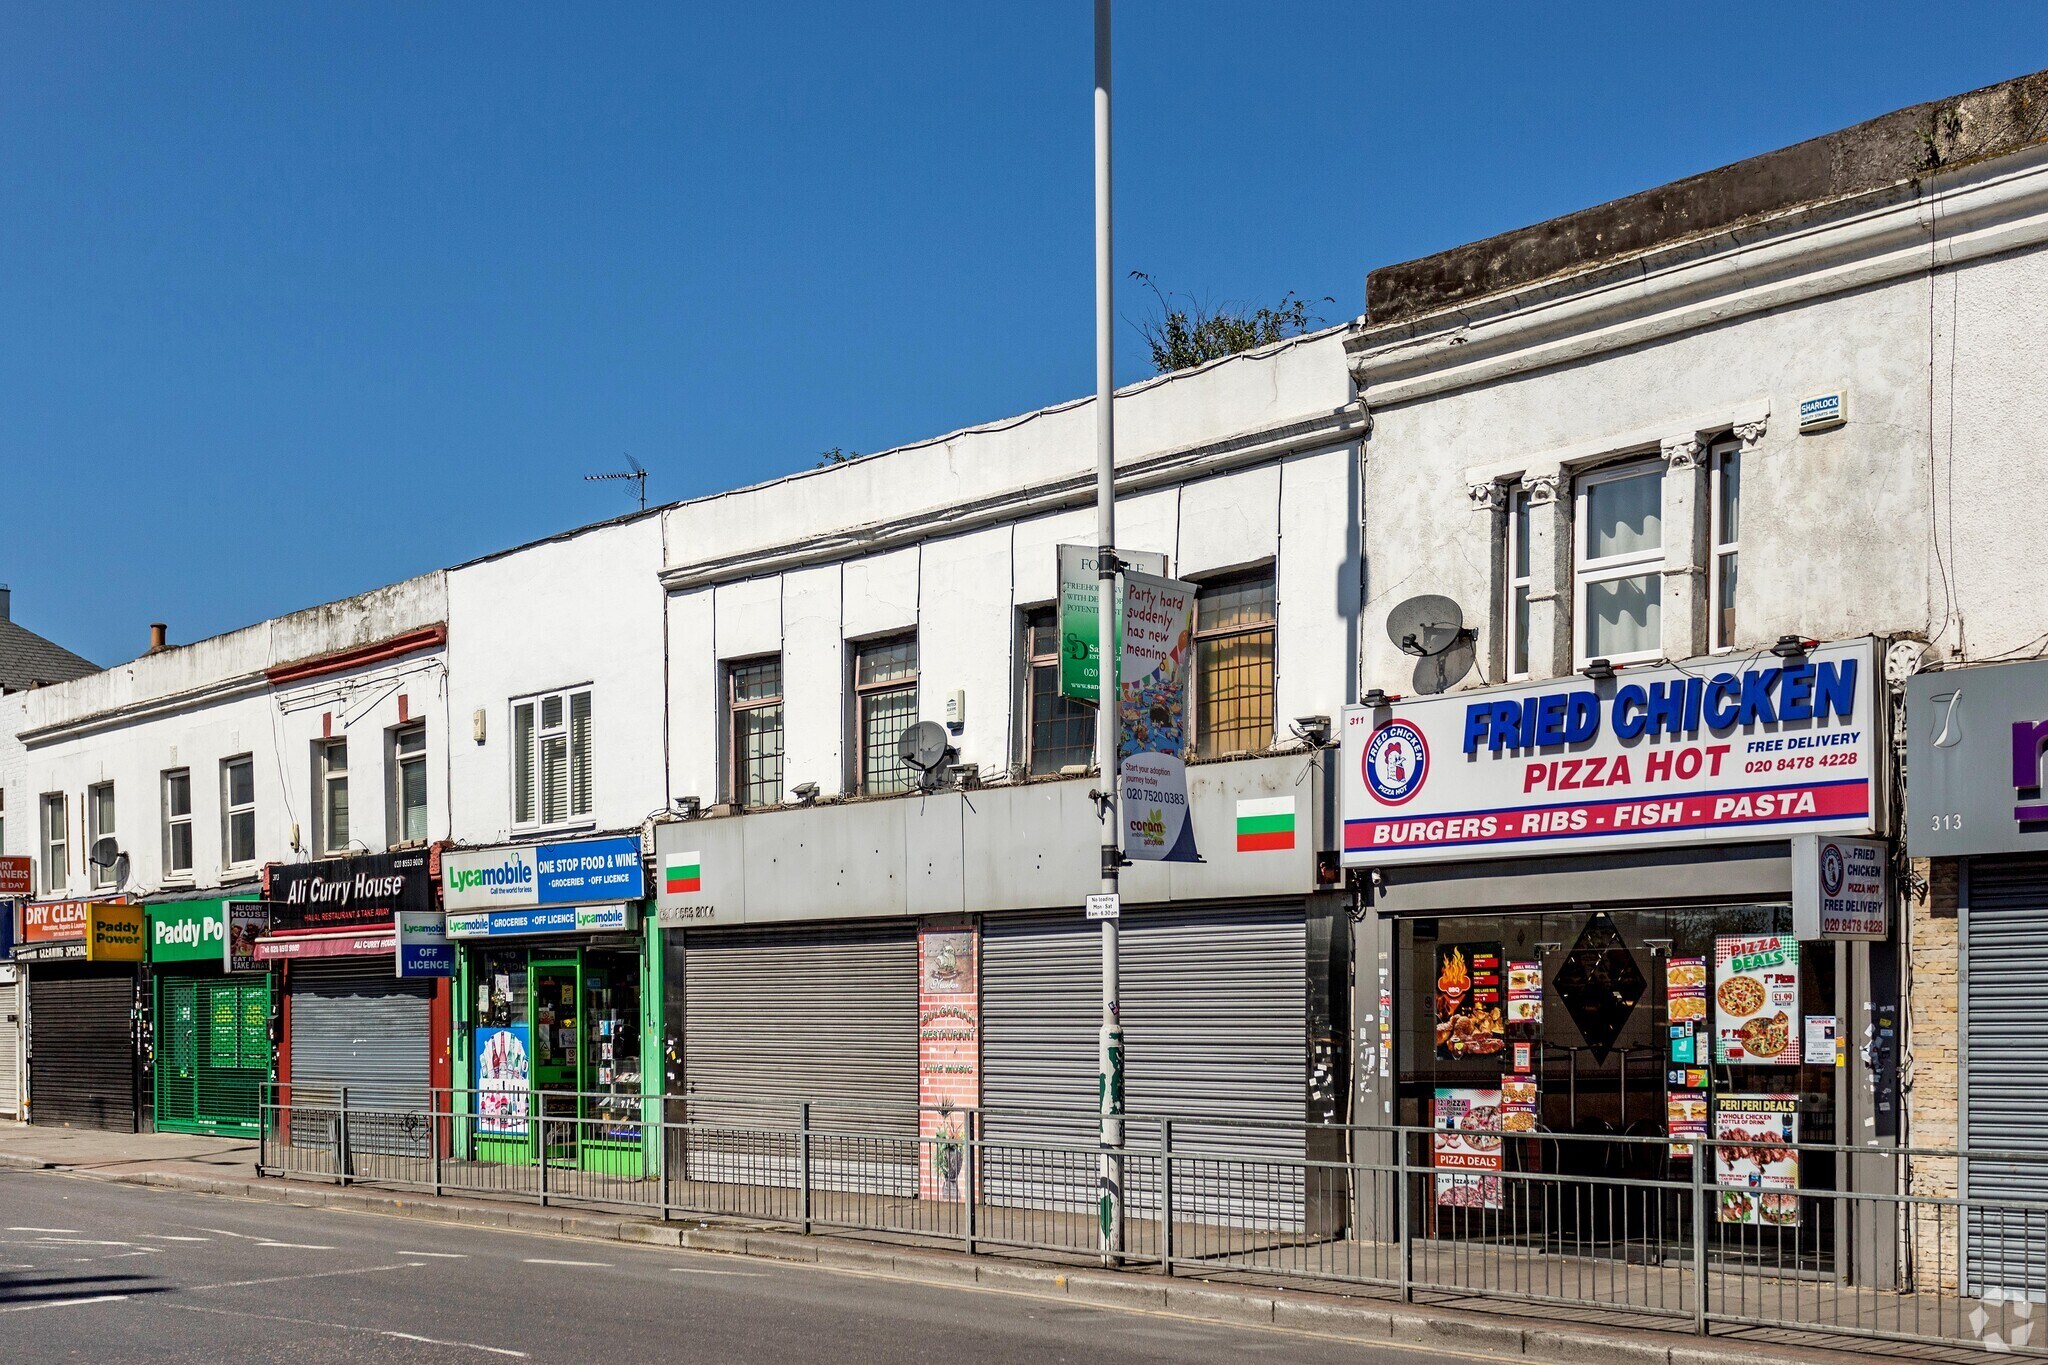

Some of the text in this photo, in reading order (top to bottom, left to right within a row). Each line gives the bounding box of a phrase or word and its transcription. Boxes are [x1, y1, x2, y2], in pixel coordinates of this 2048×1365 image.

[1801, 397, 1838, 413] SHARLOCK
[1067, 593, 1087, 601] WITH
[1128, 584, 1156, 609] Party
[1159, 591, 1185, 611] hard
[1126, 606, 1173, 632] suddenly
[1127, 621, 1169, 643] has new
[1126, 643, 1167, 672] meaning
[1083, 667, 1098, 677] 020
[1463, 658, 1858, 754] FRIED CHICKEN
[1350, 716, 1364, 726] 311
[1369, 728, 1423, 764] FRIED CHICKEN
[1747, 731, 1860, 753] FREE DELIVERY
[1125, 762, 1138, 772] Start
[1149, 767, 1171, 777] adoption
[1523, 744, 1731, 793] PIZZA HOT
[1745, 752, 1857, 774] 020 8478 4228
[1125, 774, 1158, 786] journey today
[1126, 787, 1185, 805] 020 7520 0383
[1378, 785, 1407, 795] PIZZA HOT
[1373, 816, 1498, 844] BURGERS
[1521, 809, 1588, 834] RIBS
[1613, 801, 1683, 827] FISH
[1713, 792, 1816, 819] PASTA
[1931, 813, 1962, 832] 313
[1130, 820, 1163, 833] coram
[1143, 838, 1165, 847] adoption
[1853, 847, 1875, 861] FRIED
[0, 861, 14, 870] RY
[538, 852, 637, 874] ONE STOP FOOD & WINE
[449, 860, 532, 893] Lycamobile
[1847, 864, 1881, 878] CHICKEN
[603, 873, 629, 884] LICENCE
[286, 872, 402, 906] Ali Curry House
[490, 887, 498, 895] Call
[1848, 883, 1865, 893] PIZZA
[1866, 884, 1880, 894] HOT
[1824, 899, 1883, 913] FREE DELIVERY
[26, 906, 49, 925] DRY
[304, 912, 321, 921] HALAL
[321, 910, 355, 920] RESTAURANT
[361, 908, 374, 917] TAKE
[375, 907, 390, 916] AWAY
[547, 913, 574, 924] LICENCE
[577, 909, 623, 926] Lycamobile
[96, 921, 139, 934] Paddy
[404, 921, 445, 933] Lycamobil
[449, 918, 488, 933] Lycamobile
[1824, 918, 1883, 932] 020 8478 4228
[96, 933, 140, 944] Power
[155, 918, 201, 948] Paddy
[354, 938, 397, 949] ALI CURRY HOUSE
[1730, 936, 1782, 958] PIZZA
[66, 945, 87, 957] SPECIAL
[419, 948, 438, 957] OFF
[233, 961, 250, 969] TAKE
[408, 960, 449, 969] LICENCE
[1731, 951, 1784, 972] DEALS
[922, 1004, 976, 1027] BULGARIAN
[922, 1027, 975, 1041] RESTAURANT
[924, 1063, 973, 1074] LIVE MUSIC
[1720, 1100, 1795, 1112] PERI PERI DEALS
[1440, 1155, 1497, 1167] PIZZA DEALS
